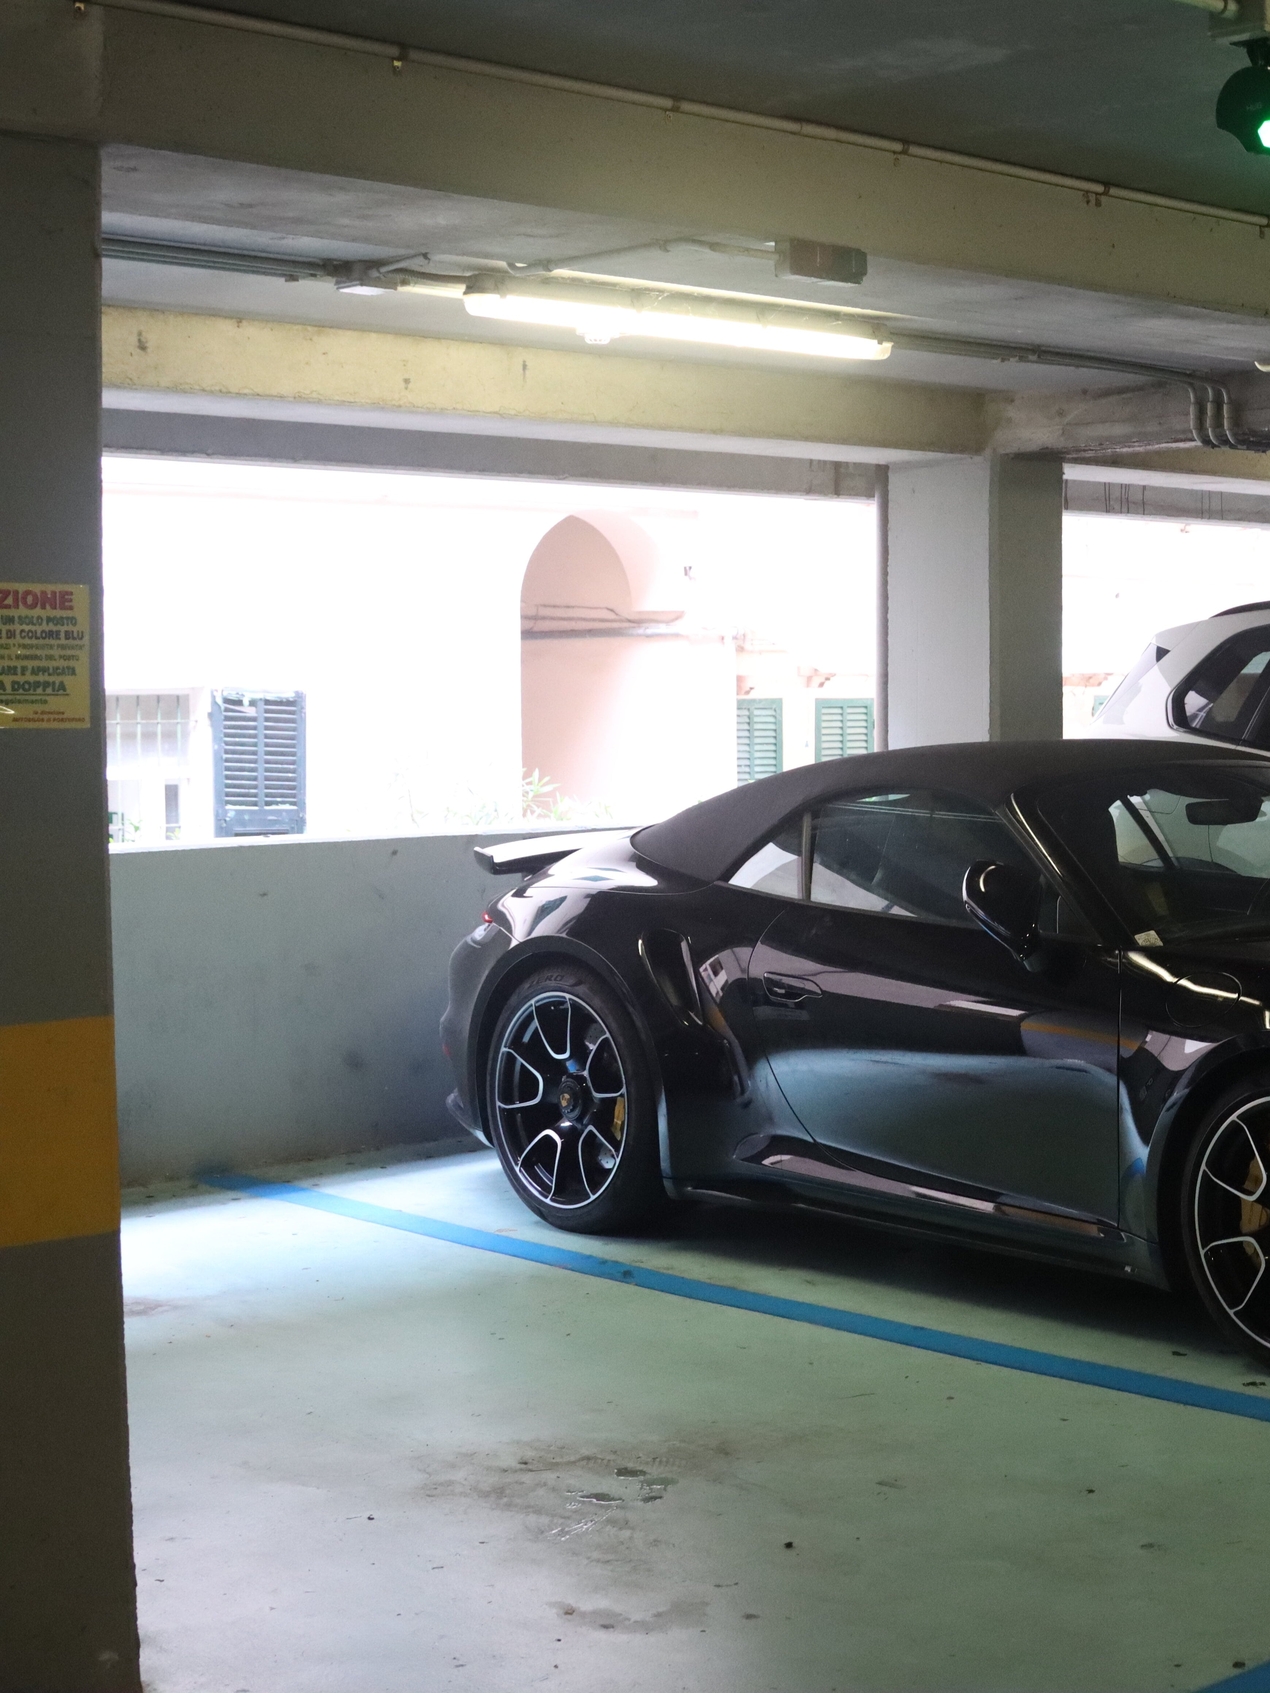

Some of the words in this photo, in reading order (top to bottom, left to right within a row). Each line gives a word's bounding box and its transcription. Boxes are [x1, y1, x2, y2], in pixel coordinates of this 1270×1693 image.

[0, 588, 74, 611] ZIONE
[17, 614, 44, 627] SOLO
[45, 615, 78, 628] POSTO
[6, 629, 16, 640] DI
[19, 628, 62, 641] COLORE
[64, 629, 84, 641] BLU
[58, 654, 80, 662] POSTO
[30, 665, 77, 677] APPLICATA
[11, 680, 67, 693] DOPPIA
